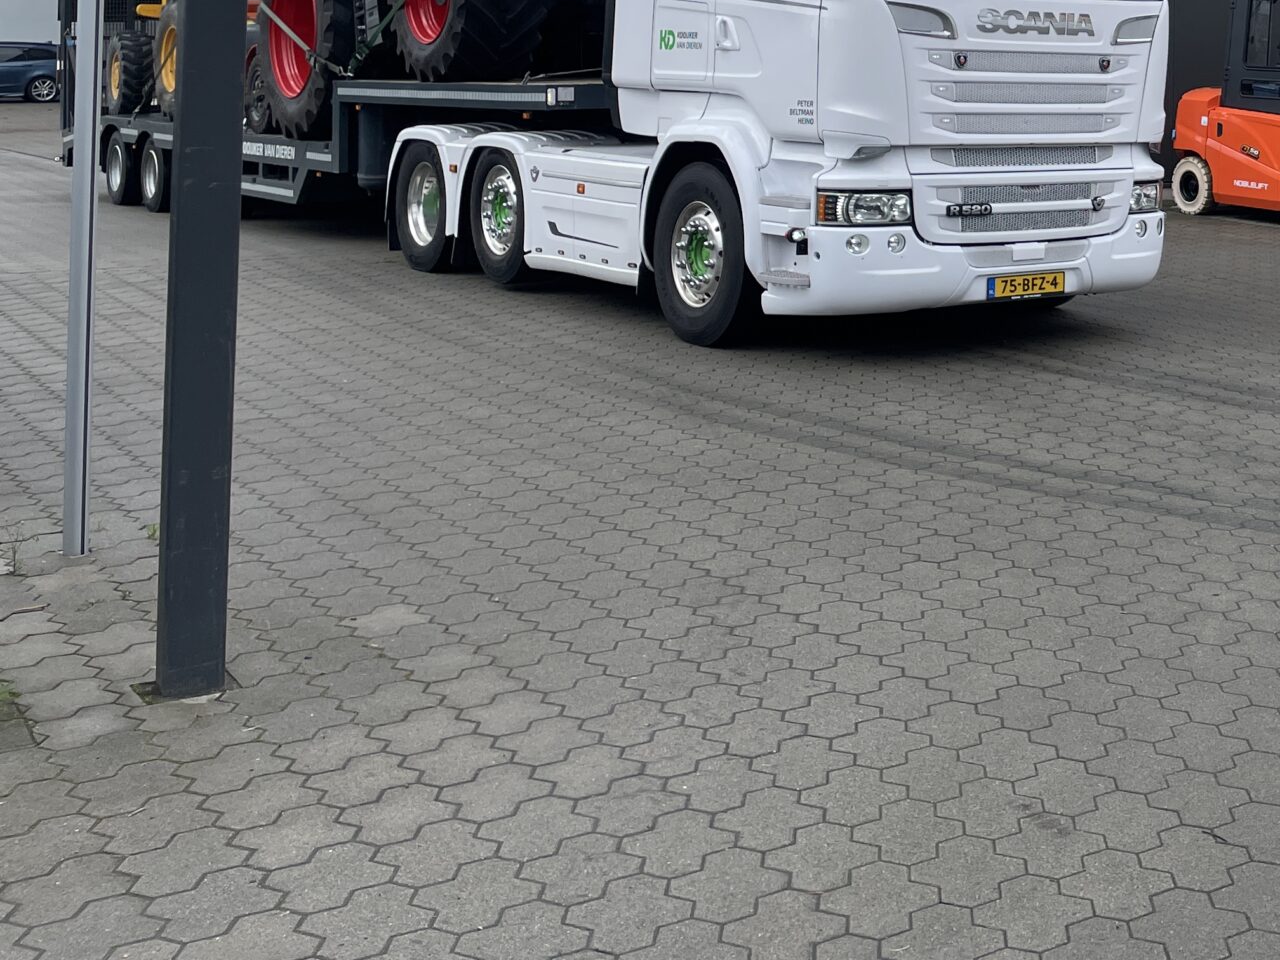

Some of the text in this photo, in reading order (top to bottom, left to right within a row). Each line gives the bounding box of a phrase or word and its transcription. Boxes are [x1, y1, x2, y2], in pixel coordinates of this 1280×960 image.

[976, 8, 1095, 37] SCANIA
[789, 108, 814, 116] BELTMAN
[1233, 179, 1269, 191] NOBLELIFT
[950, 204, 990, 216] R 520
[1001, 276, 1059, 294] 75-BFZ-4
